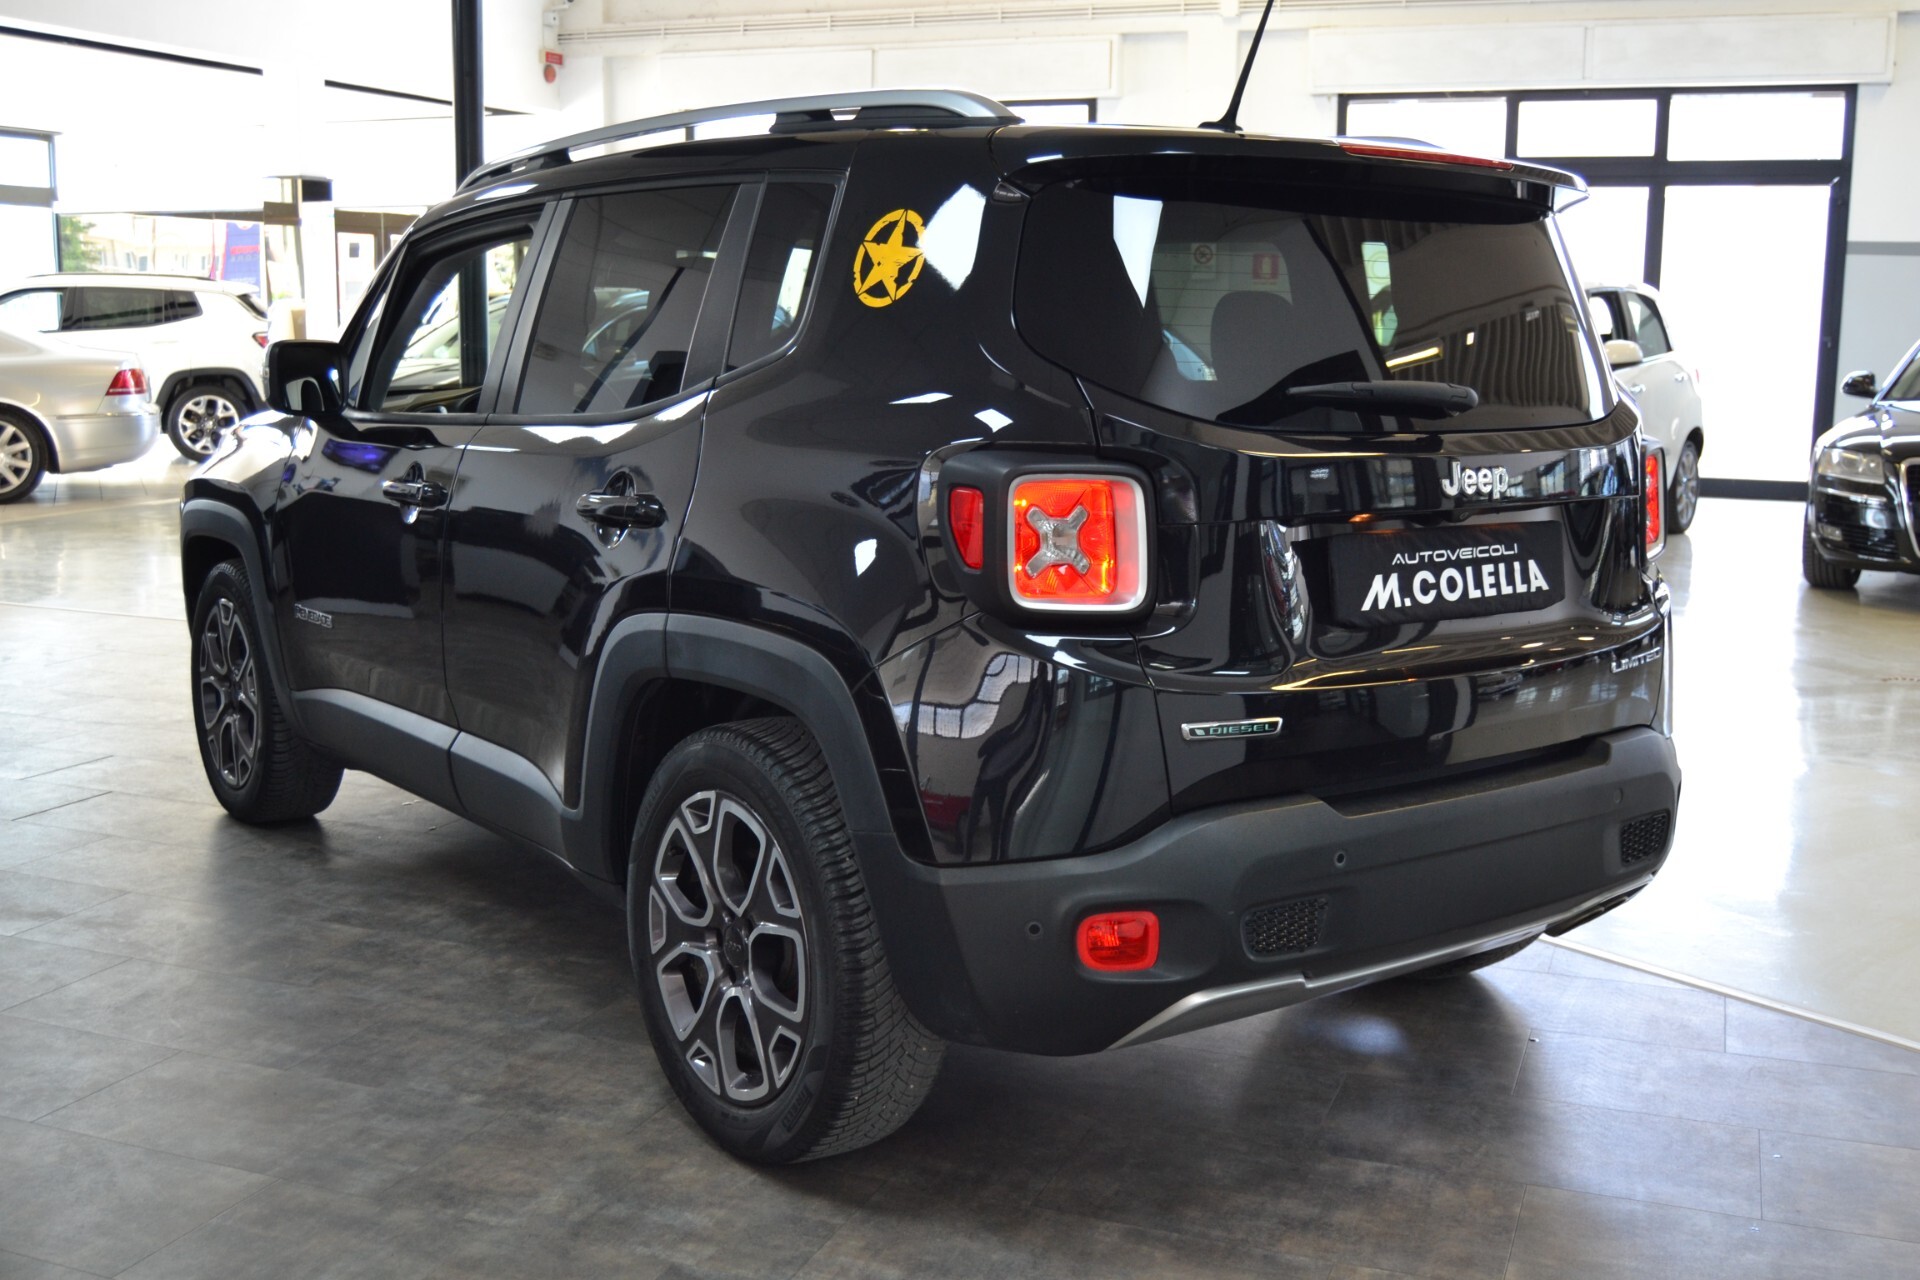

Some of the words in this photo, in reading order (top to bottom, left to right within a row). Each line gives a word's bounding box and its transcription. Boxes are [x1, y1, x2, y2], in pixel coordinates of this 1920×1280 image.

[1441, 461, 1509, 499] Jeep
[1392, 543, 1518, 566] AUTOVEICOLI
[1361, 559, 1550, 611] M.COLELLA
[1611, 646, 1661, 673] LIMITED
[1209, 723, 1275, 736] DIESEL
